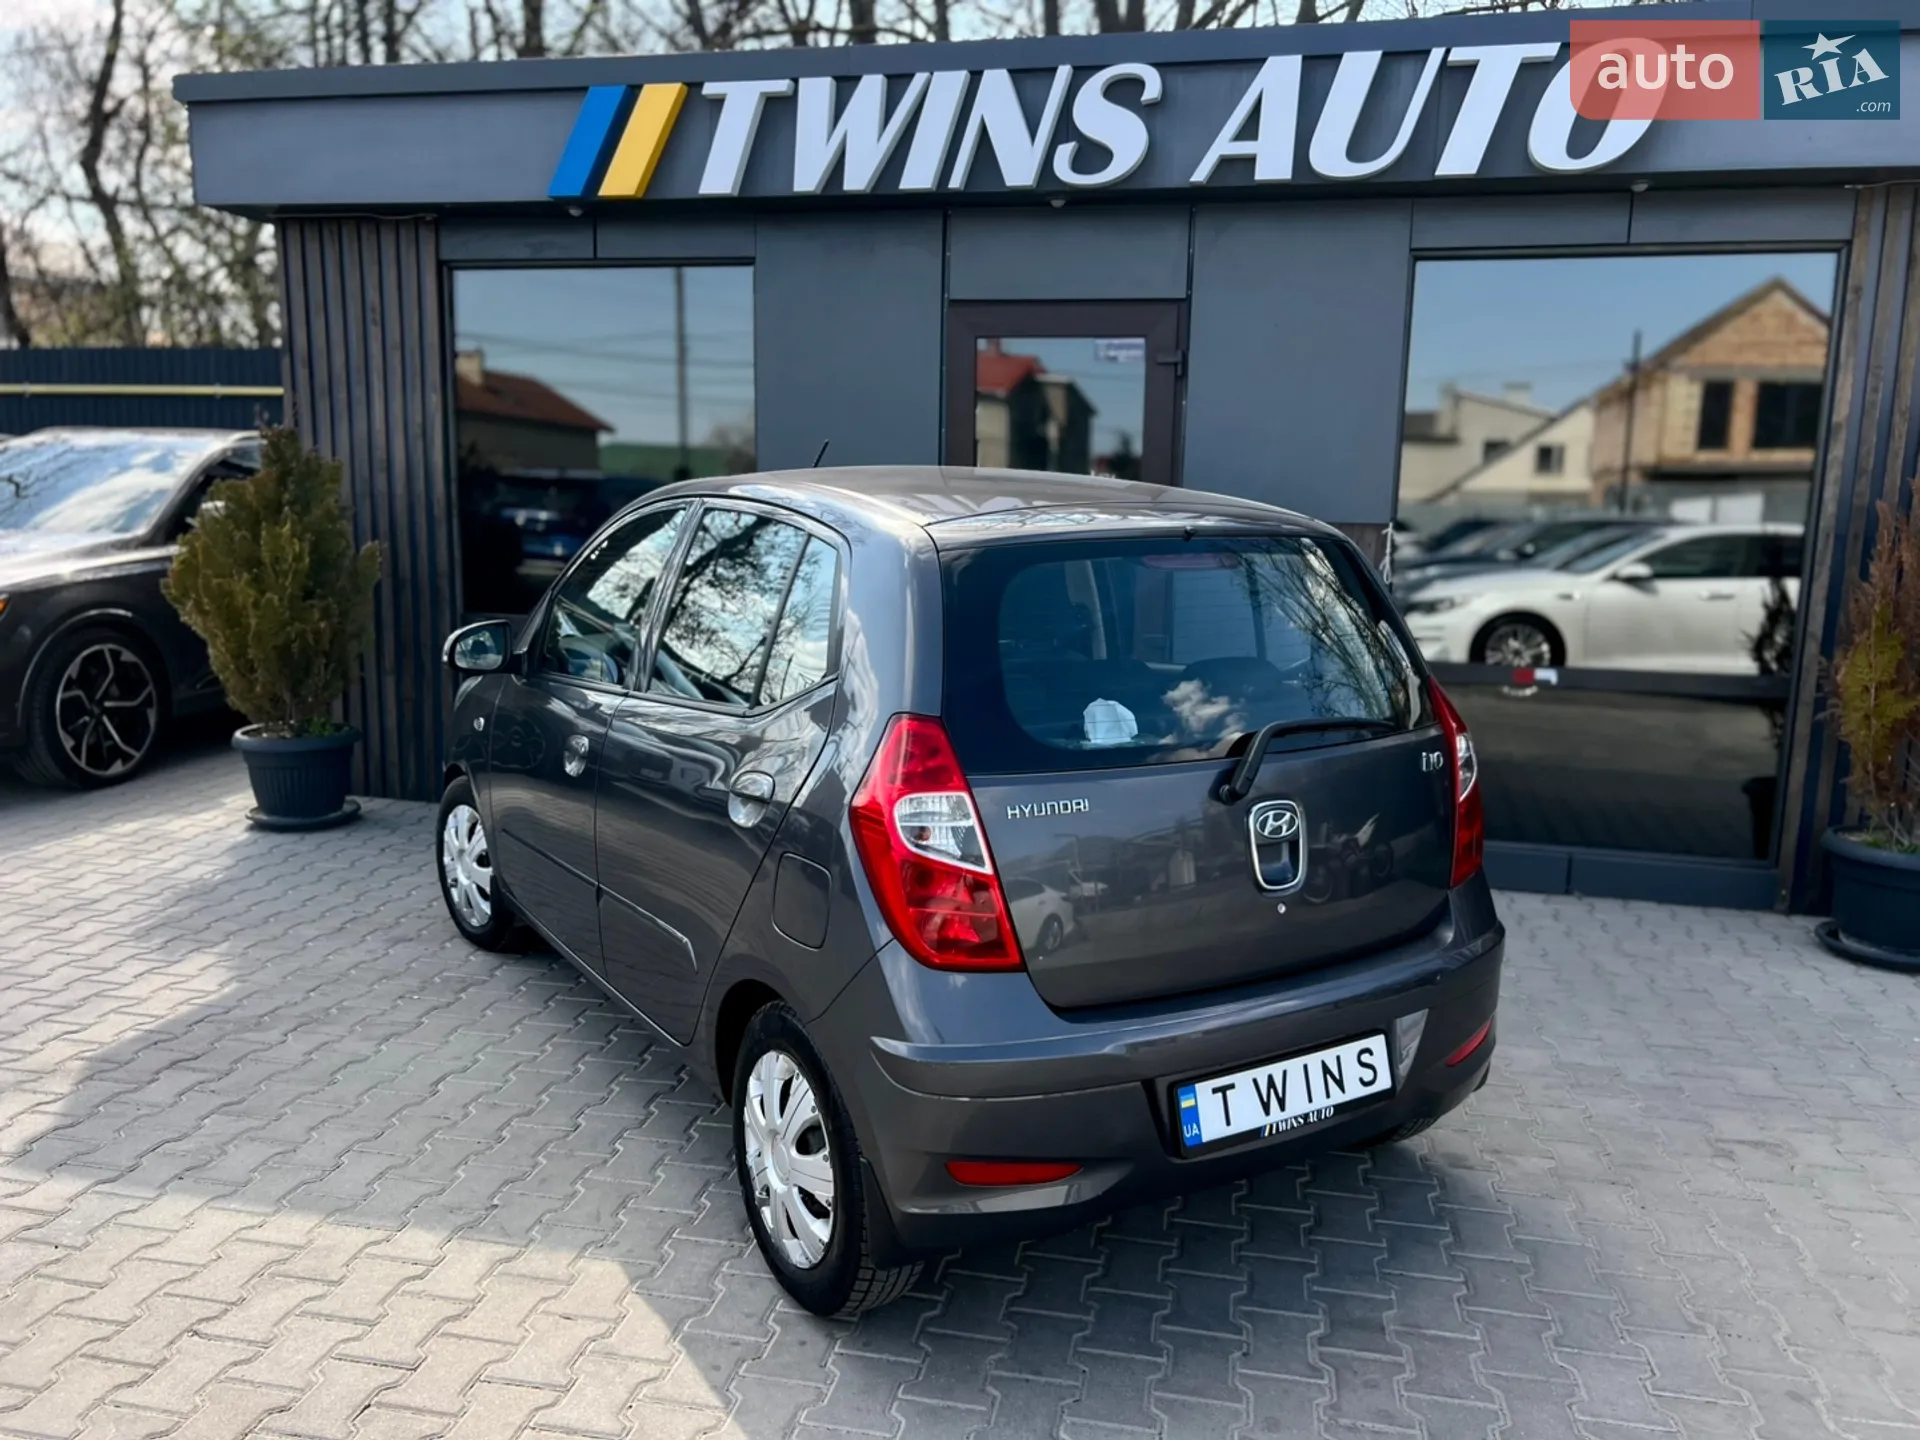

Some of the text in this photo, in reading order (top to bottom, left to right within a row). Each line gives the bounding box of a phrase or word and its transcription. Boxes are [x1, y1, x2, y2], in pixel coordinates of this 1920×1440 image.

[697, 37, 1672, 196] TWINS AUTO
[1421, 751, 1444, 772] i10
[1006, 798, 1090, 820] HYUNDAI
[1211, 1046, 1378, 1127] TWINS
[1183, 1122, 1200, 1138] UA
[1271, 1105, 1335, 1136] TWINS AUTO
